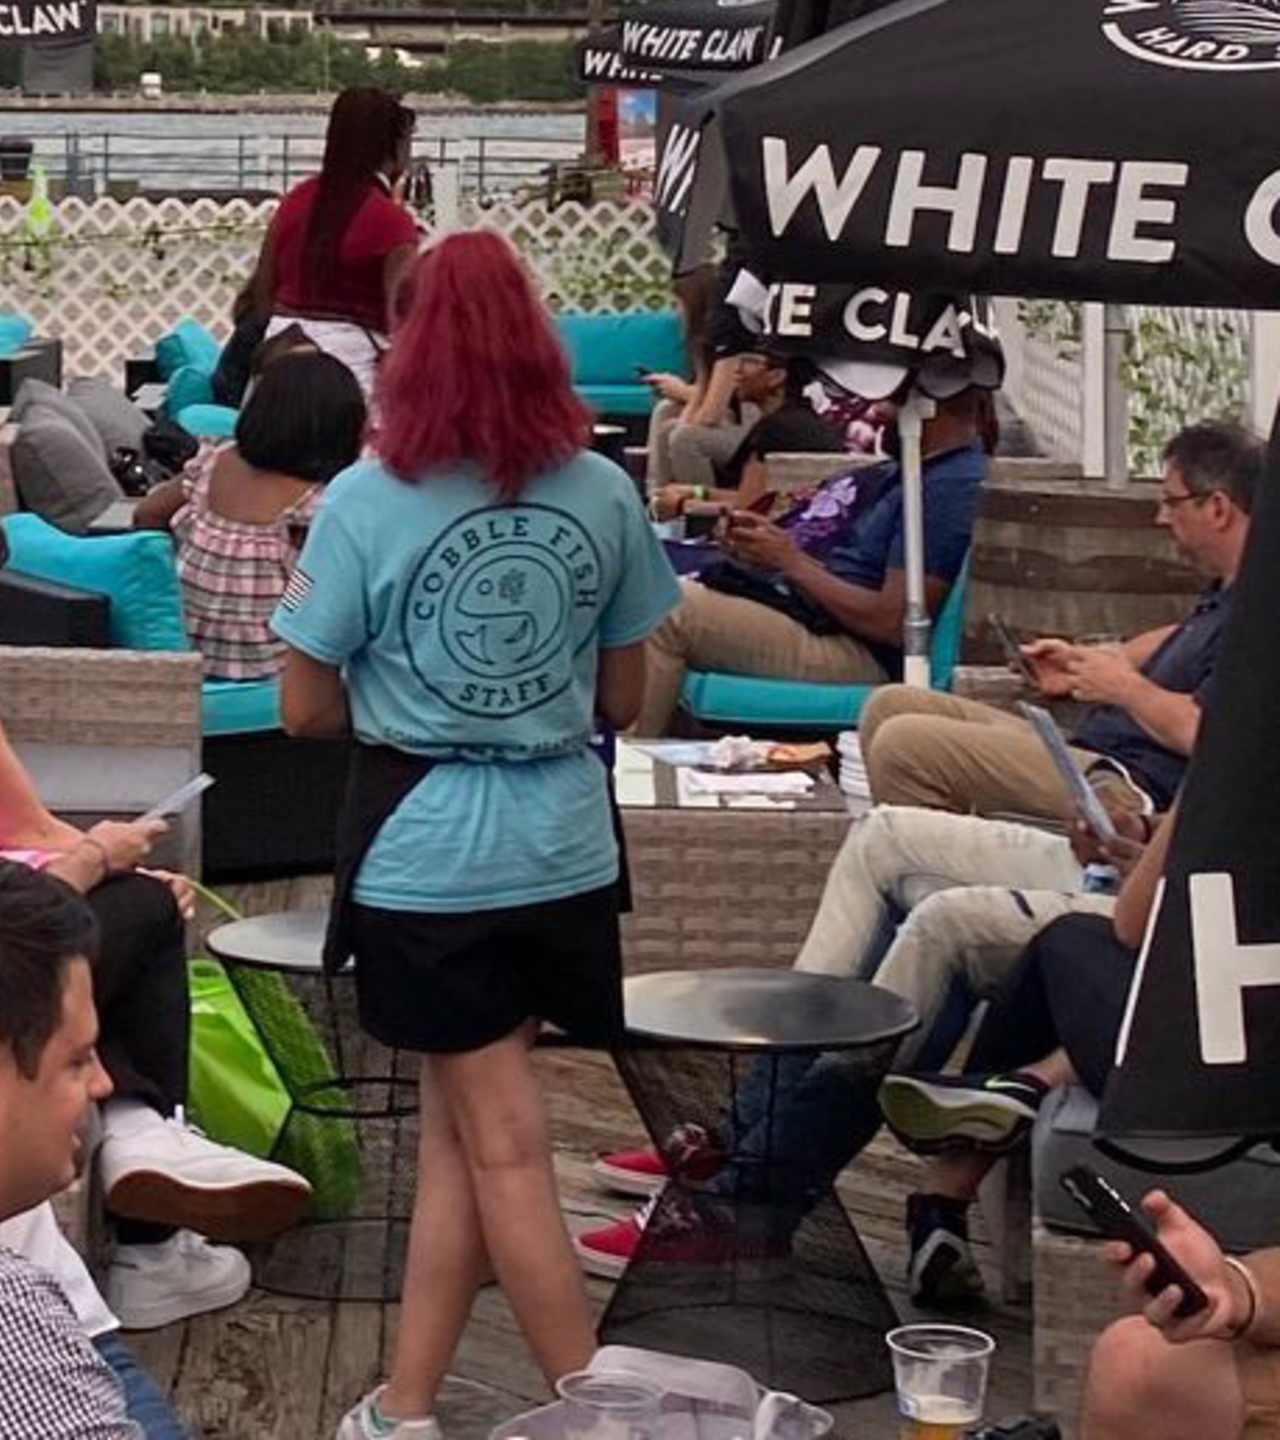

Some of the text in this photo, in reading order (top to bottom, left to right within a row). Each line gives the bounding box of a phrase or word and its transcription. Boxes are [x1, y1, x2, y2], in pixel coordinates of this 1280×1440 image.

[623, 21, 701, 60] WHITE
[702, 26, 759, 61] CLAW
[1135, 27, 1250, 60] HARD
[761, 135, 1189, 262] WHITE
[843, 287, 967, 358] CLA
[414, 516, 598, 620] COBBLE FISH
[459, 673, 550, 707] STAFF
